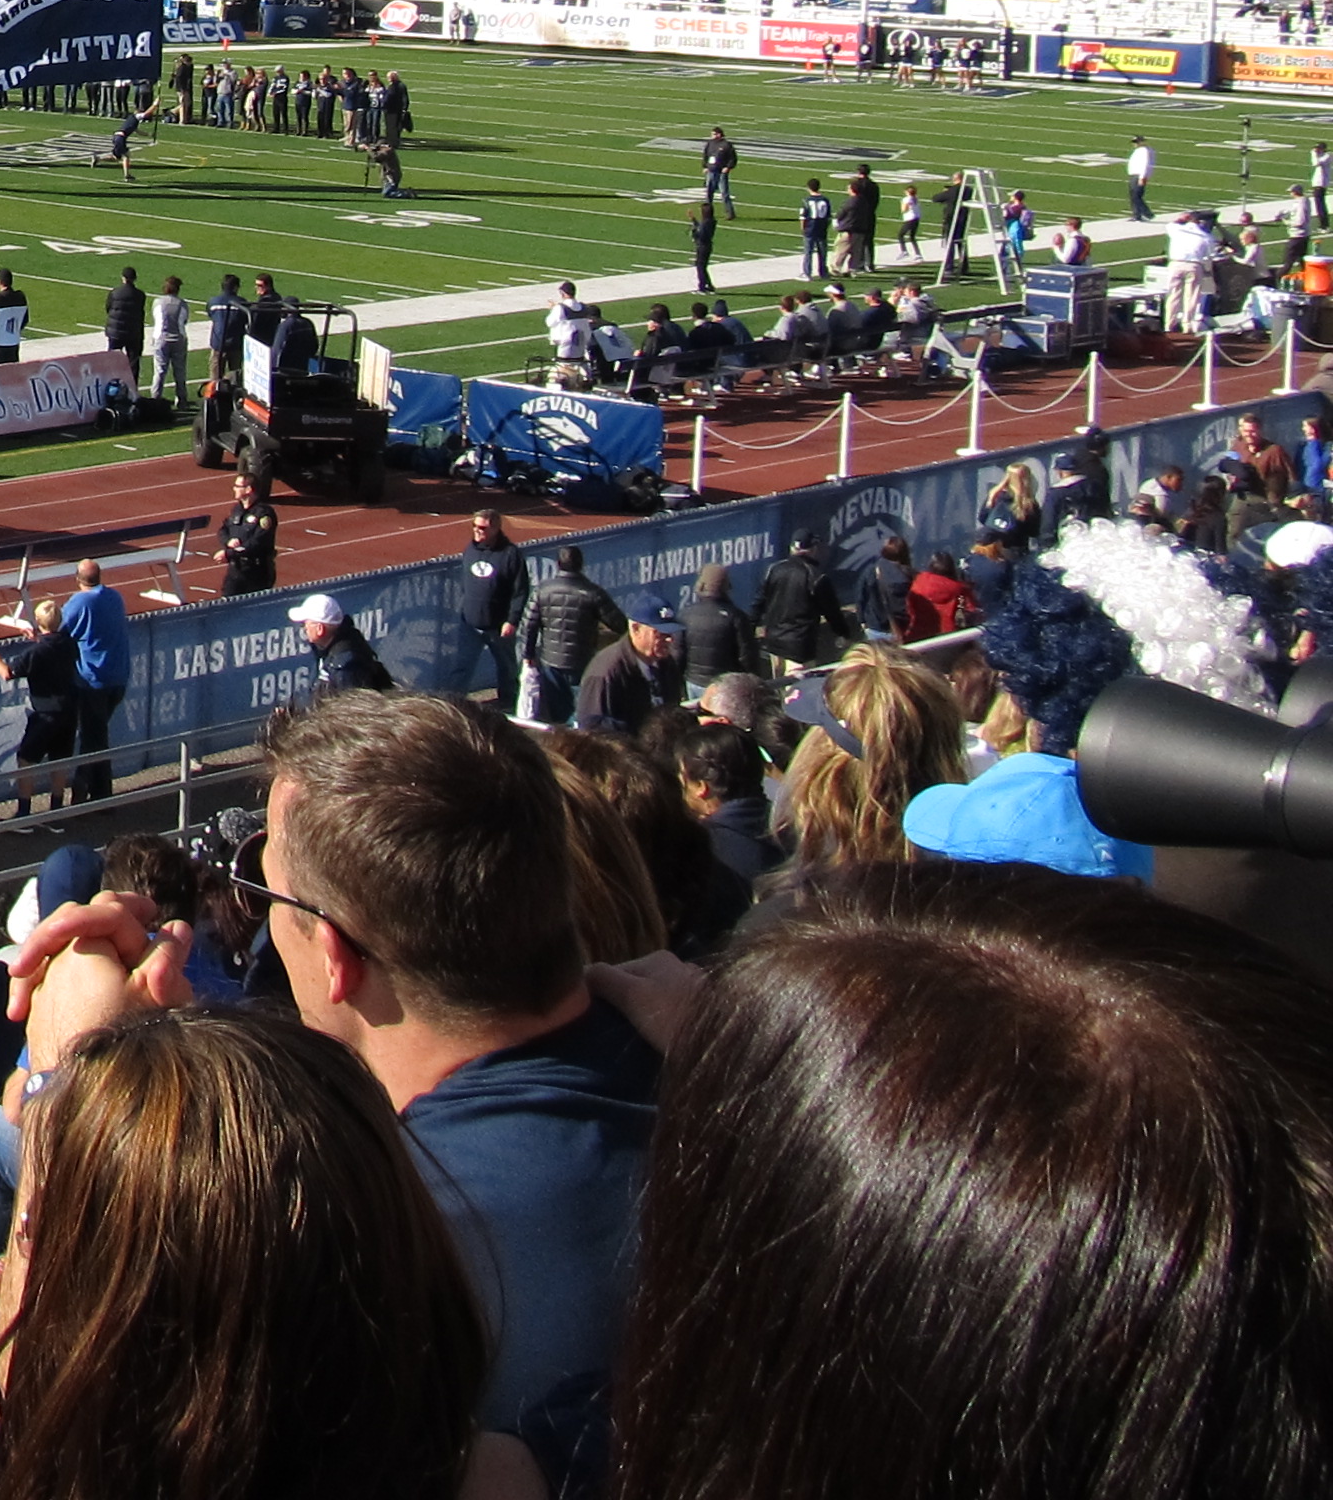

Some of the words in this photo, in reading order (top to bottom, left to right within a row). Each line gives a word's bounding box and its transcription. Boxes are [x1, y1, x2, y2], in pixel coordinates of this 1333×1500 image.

[557, 10, 631, 28] Jensen
[654, 17, 749, 36] SCHEELS
[162, 21, 237, 42] GEICO
[762, 26, 807, 42] TEAM
[1123, 54, 1171, 67] SCHWAB
[1254, 69, 1291, 78] WOLF
[12, 399, 31, 421] by
[521, 396, 599, 431] NEVADA
[827, 484, 916, 543] NEVADA
[720, 533, 775, 569] BOWL
[174, 643, 226, 678] LAS
[232, 628, 312, 674] VEGAS
